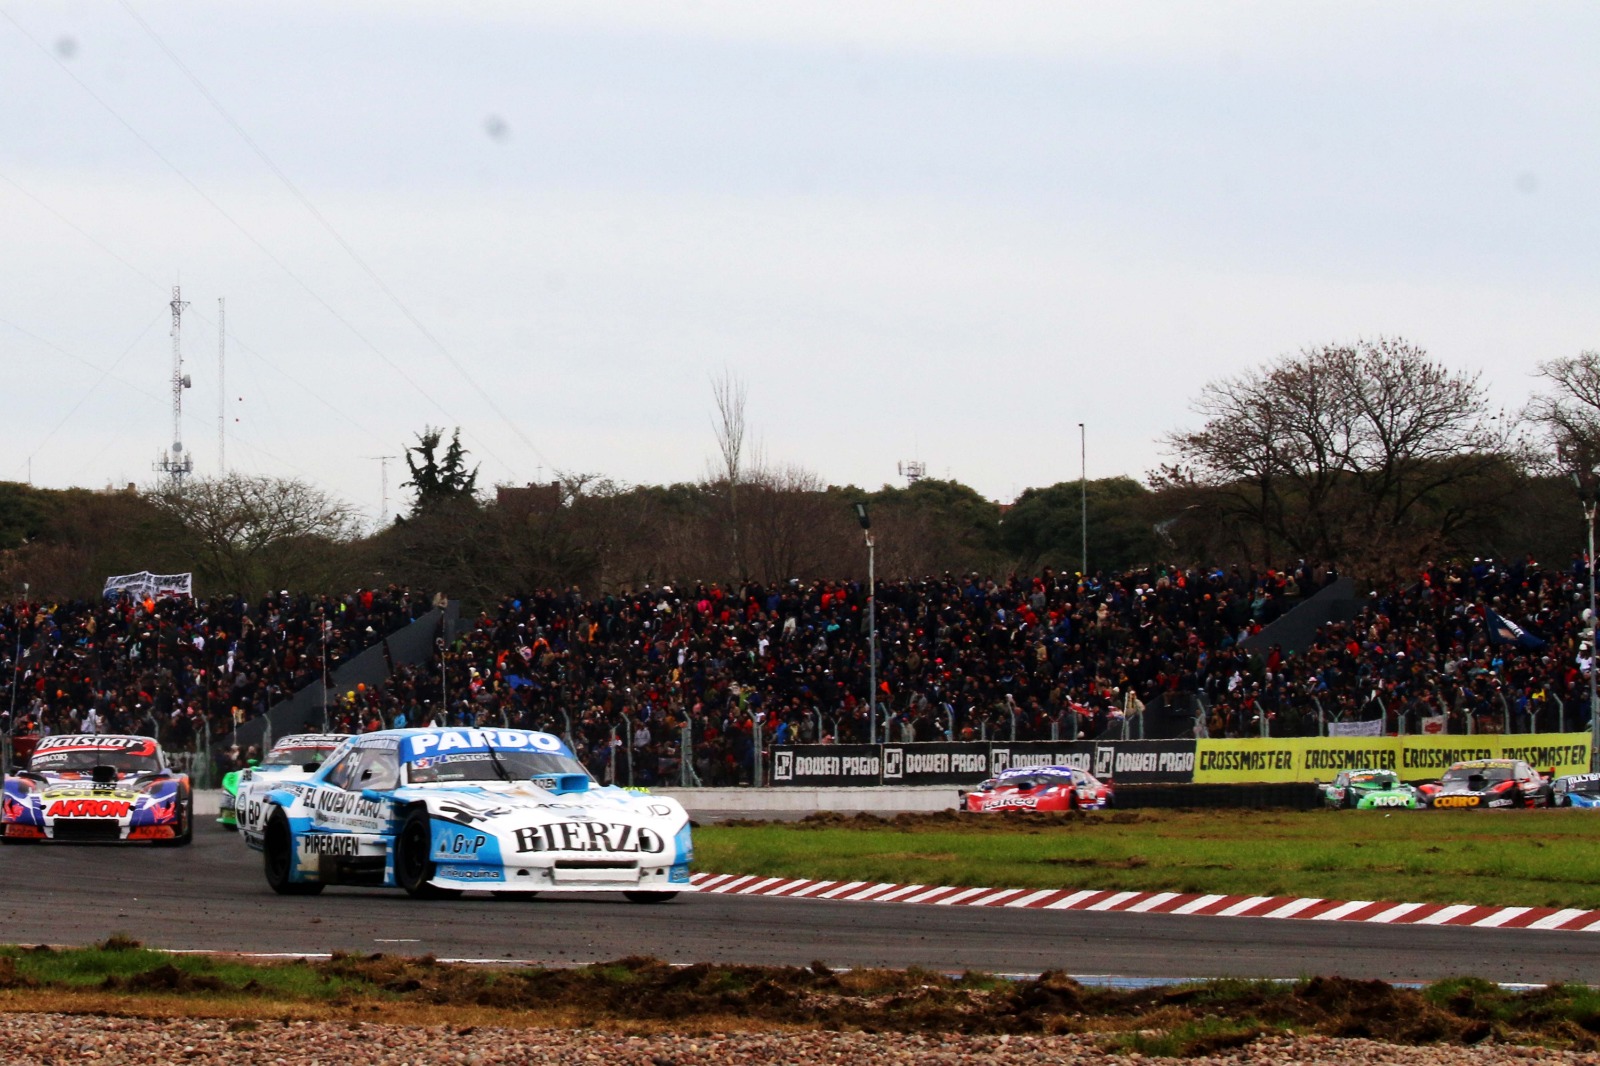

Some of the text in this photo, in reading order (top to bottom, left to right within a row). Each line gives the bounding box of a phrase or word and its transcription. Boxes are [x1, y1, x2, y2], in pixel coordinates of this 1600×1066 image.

[410, 731, 561, 755] PARDO
[449, 753, 504, 762] MOTOML
[795, 756, 880, 776] DOWEN PAGIO
[906, 753, 986, 773] DOWEN PAGIO
[1116, 752, 1195, 772] DOWEN PAGIO
[1200, 750, 1292, 770] CROSSMASTER
[1305, 749, 1396, 769] CROSSMASTER
[1403, 747, 1491, 768] CROSSMASTER
[47, 799, 131, 818] AKRON
[303, 788, 317, 809] EL
[318, 791, 355, 814] NUEVO
[1434, 796, 1480, 808] COIRO
[304, 835, 359, 855] PIRERAYEN
[512, 822, 666, 854] BIERZO
